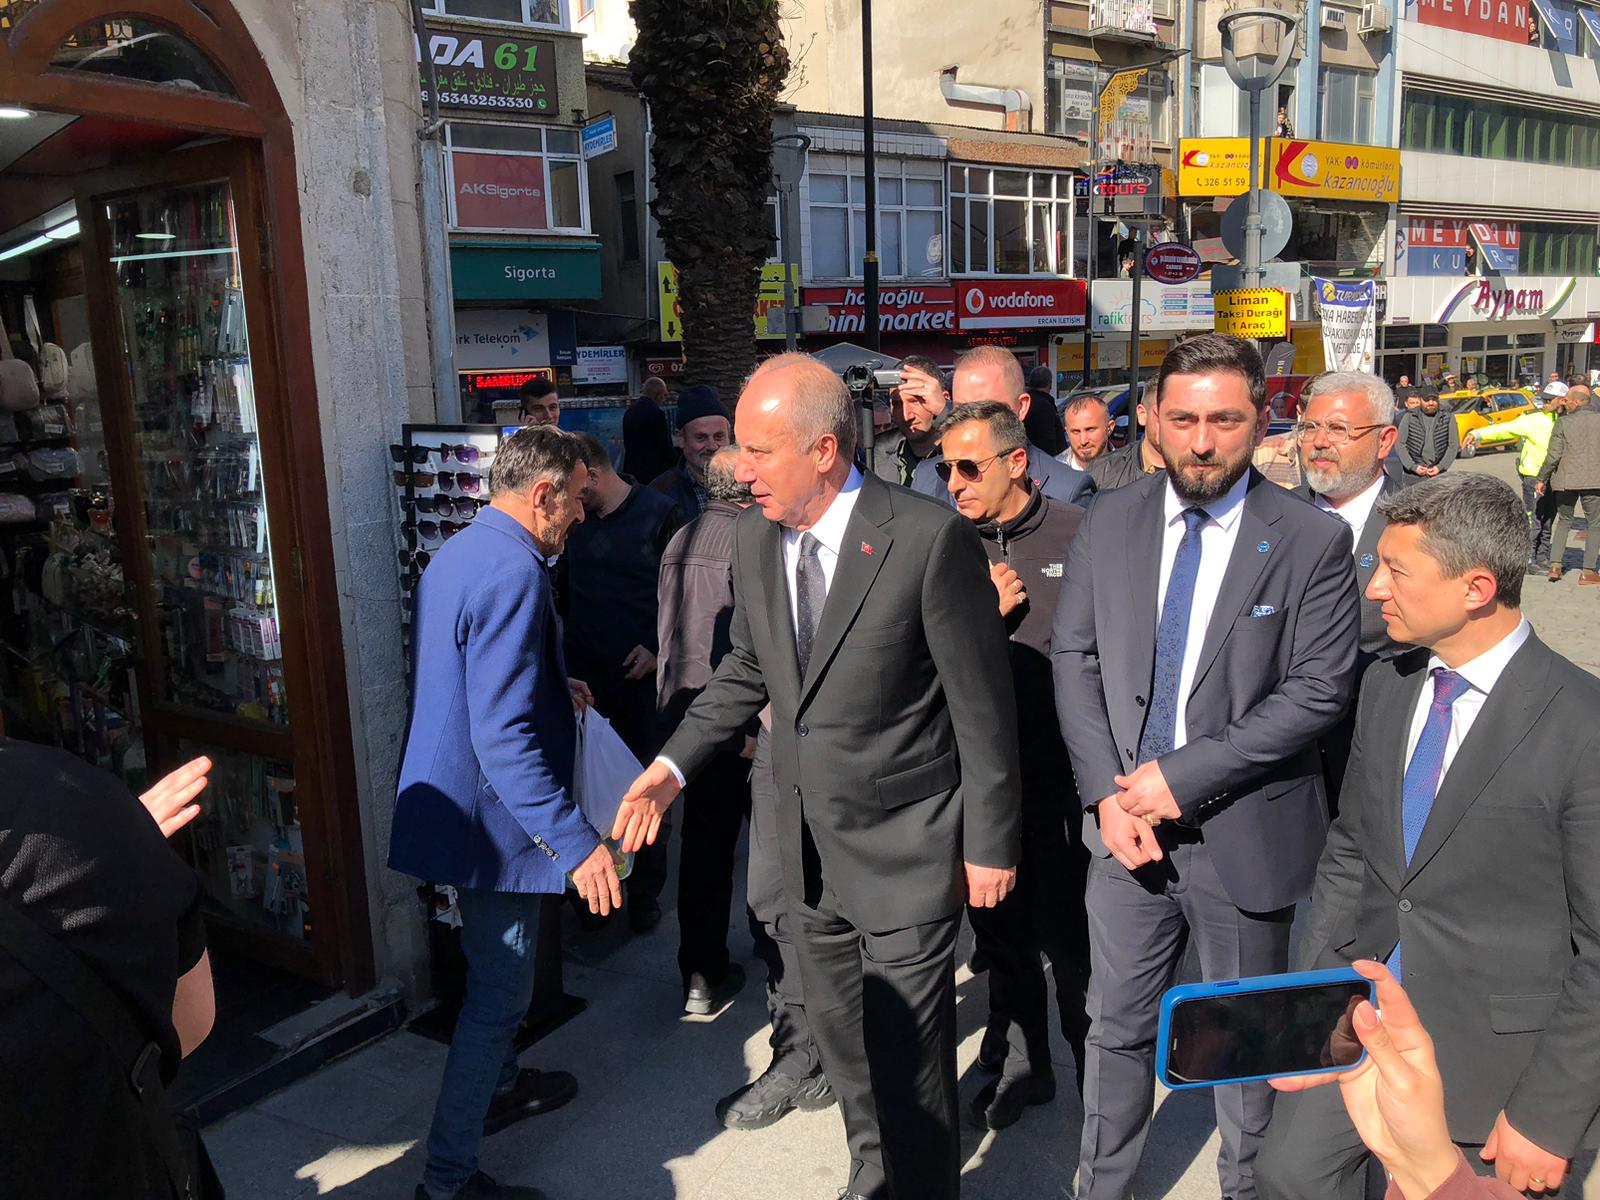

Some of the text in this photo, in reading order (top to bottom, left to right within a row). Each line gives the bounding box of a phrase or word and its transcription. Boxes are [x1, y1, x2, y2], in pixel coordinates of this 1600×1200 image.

[414, 33, 538, 72] DA 61
[1205, 178, 1245, 187] 326 51 59
[504, 265, 556, 286] Sigorta
[989, 291, 1054, 308] vodafone
[1229, 296, 1268, 306] Liman
[1473, 280, 1543, 319] Aypam
[879, 310, 956, 331] market
[1217, 308, 1283, 319] Taksi Durağı
[473, 333, 521, 344] Telekom
[576, 349, 625, 359] YDEMİRLER
